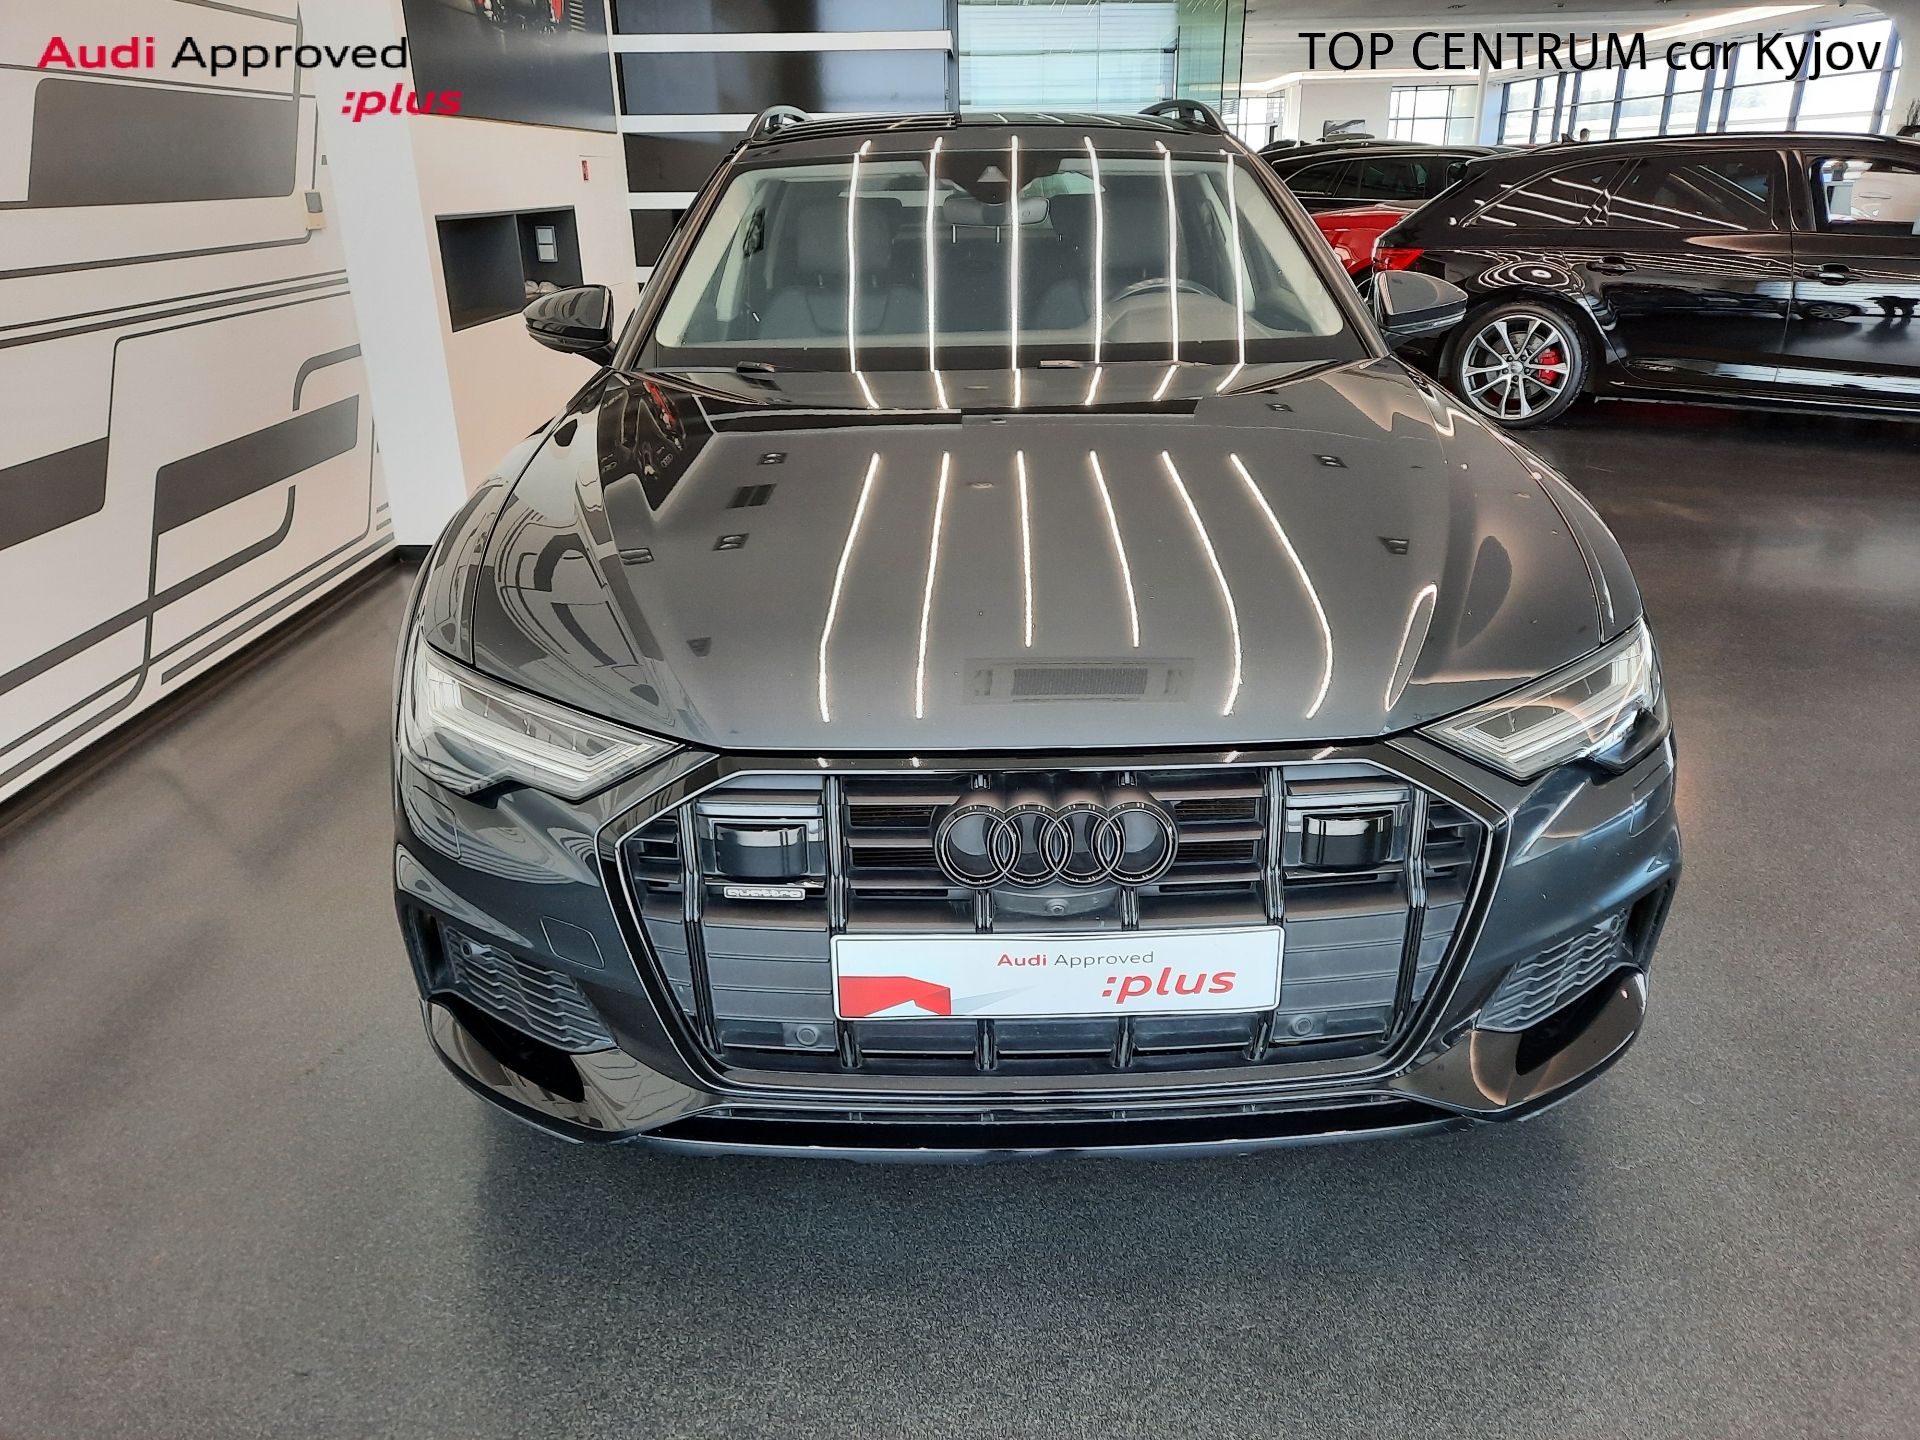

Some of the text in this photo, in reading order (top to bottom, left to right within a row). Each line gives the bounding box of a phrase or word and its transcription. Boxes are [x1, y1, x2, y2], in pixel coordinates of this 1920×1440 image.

[726, 888, 803, 898] quattro
[996, 950, 1155, 968] Audi Approved
[1101, 967, 1237, 1005] :plus
